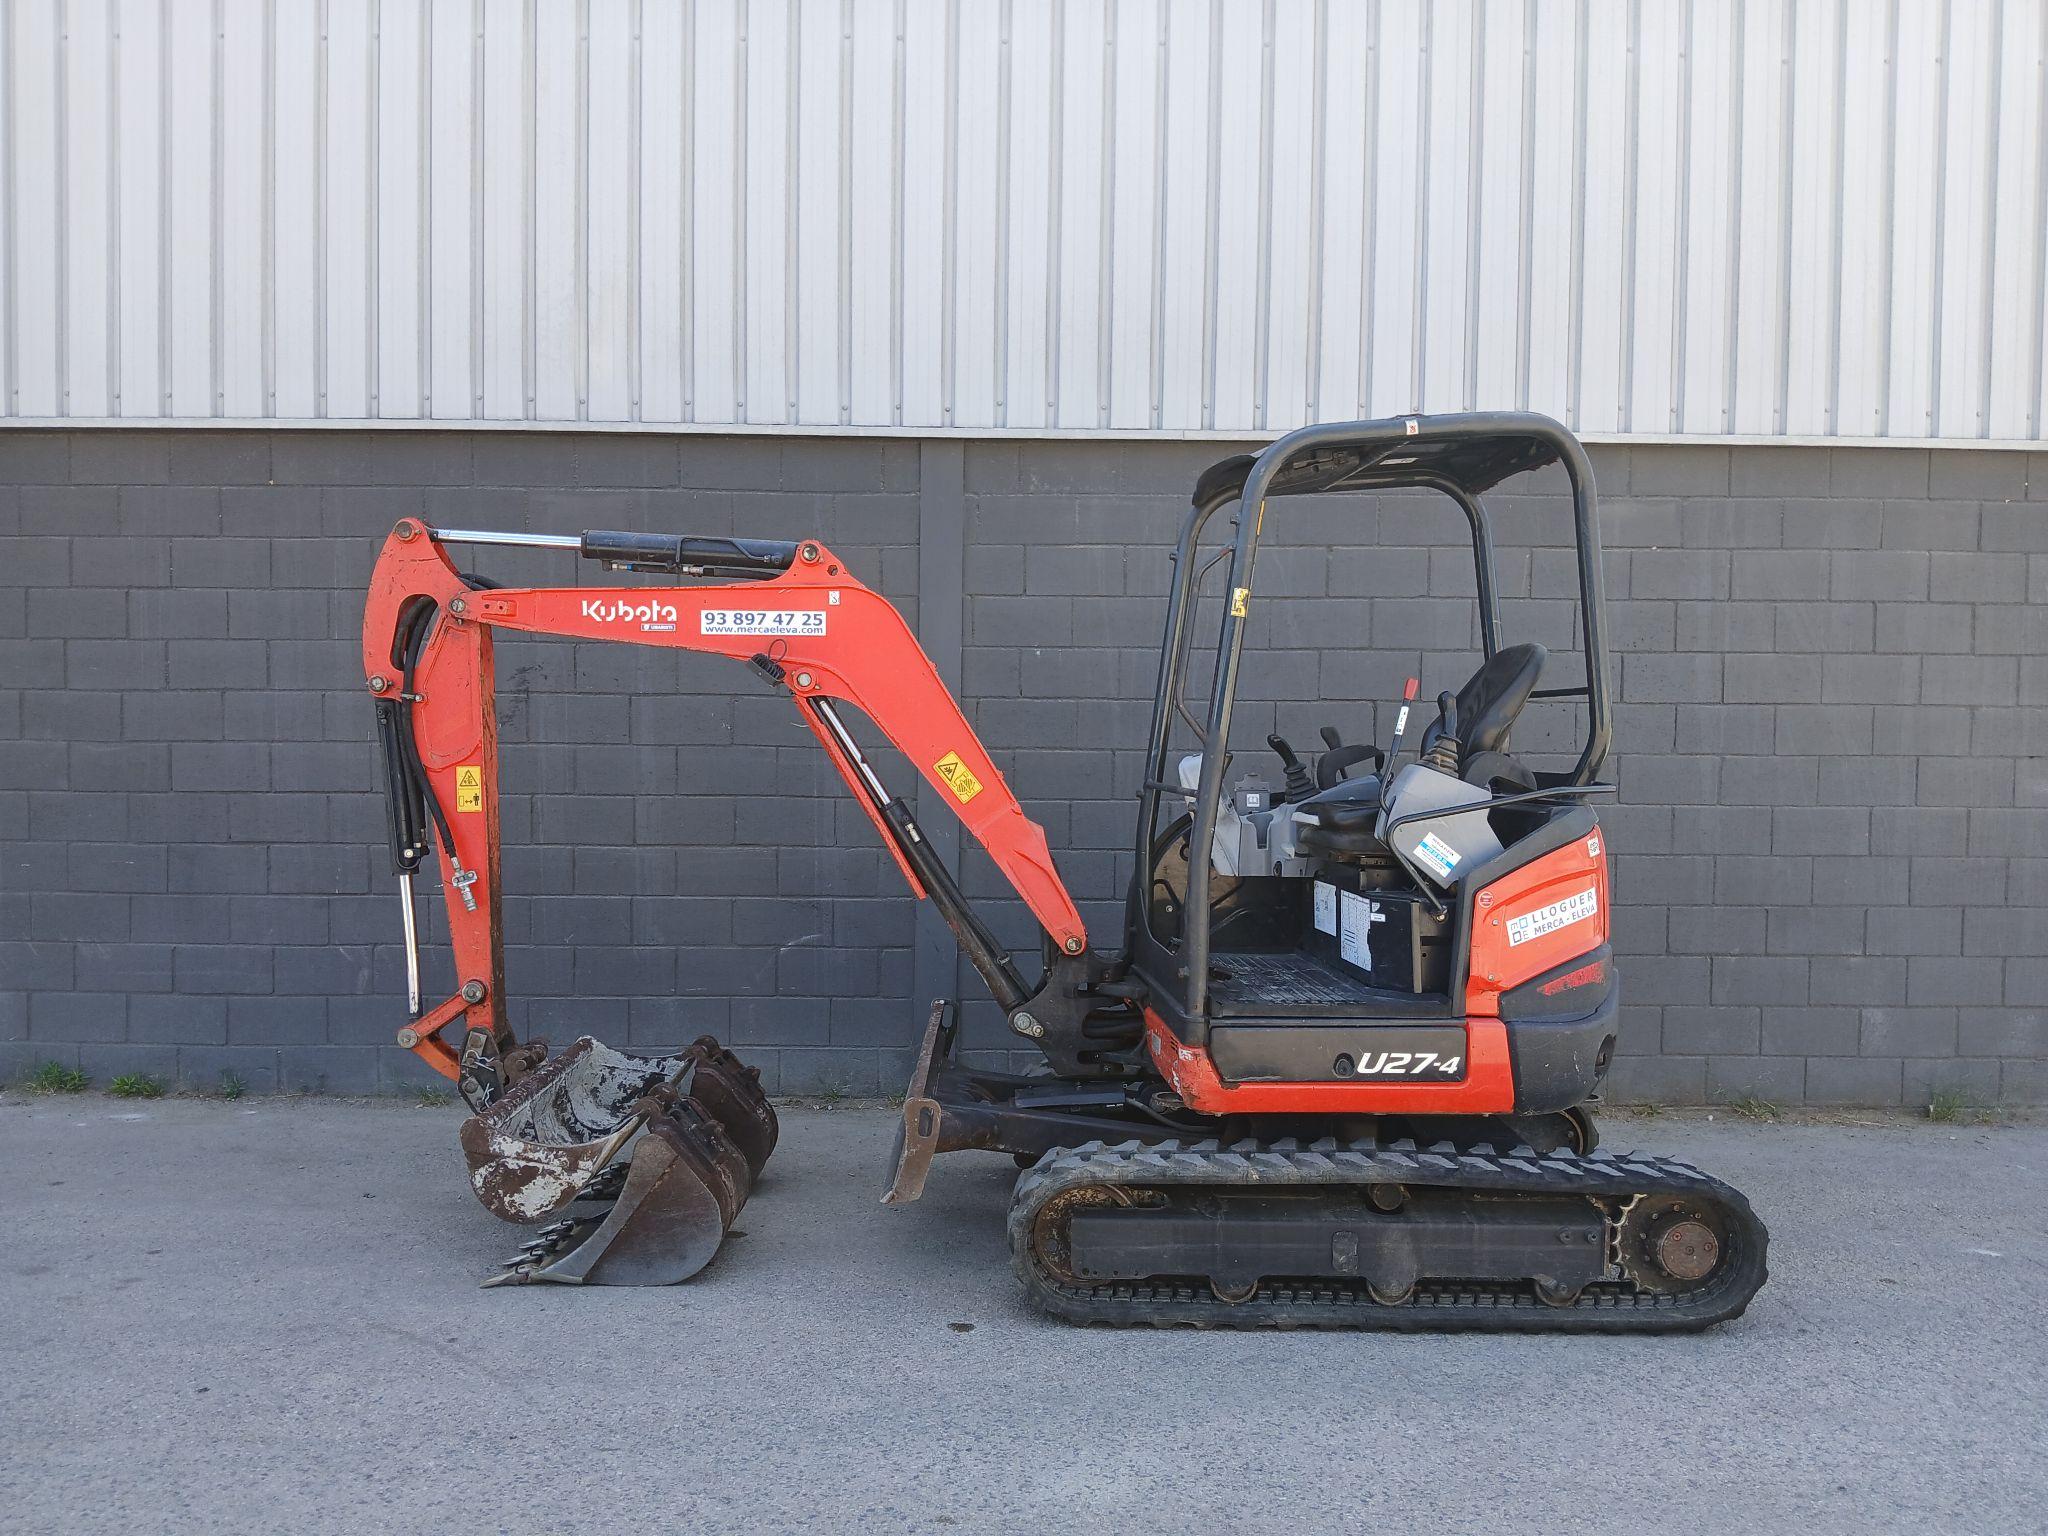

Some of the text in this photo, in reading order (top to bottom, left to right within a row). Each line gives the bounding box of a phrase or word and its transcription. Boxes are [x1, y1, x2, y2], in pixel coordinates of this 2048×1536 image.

[581, 600, 677, 622] Kubota
[704, 612, 823, 626] 93 897 47 25
[705, 625, 823, 636] www.mercaeleva.com
[1532, 891, 1594, 923] LLOGUER
[1534, 917, 1565, 936] MERCA
[1572, 904, 1595, 920] ELEVA
[1356, 1052, 1461, 1074] U27-4
